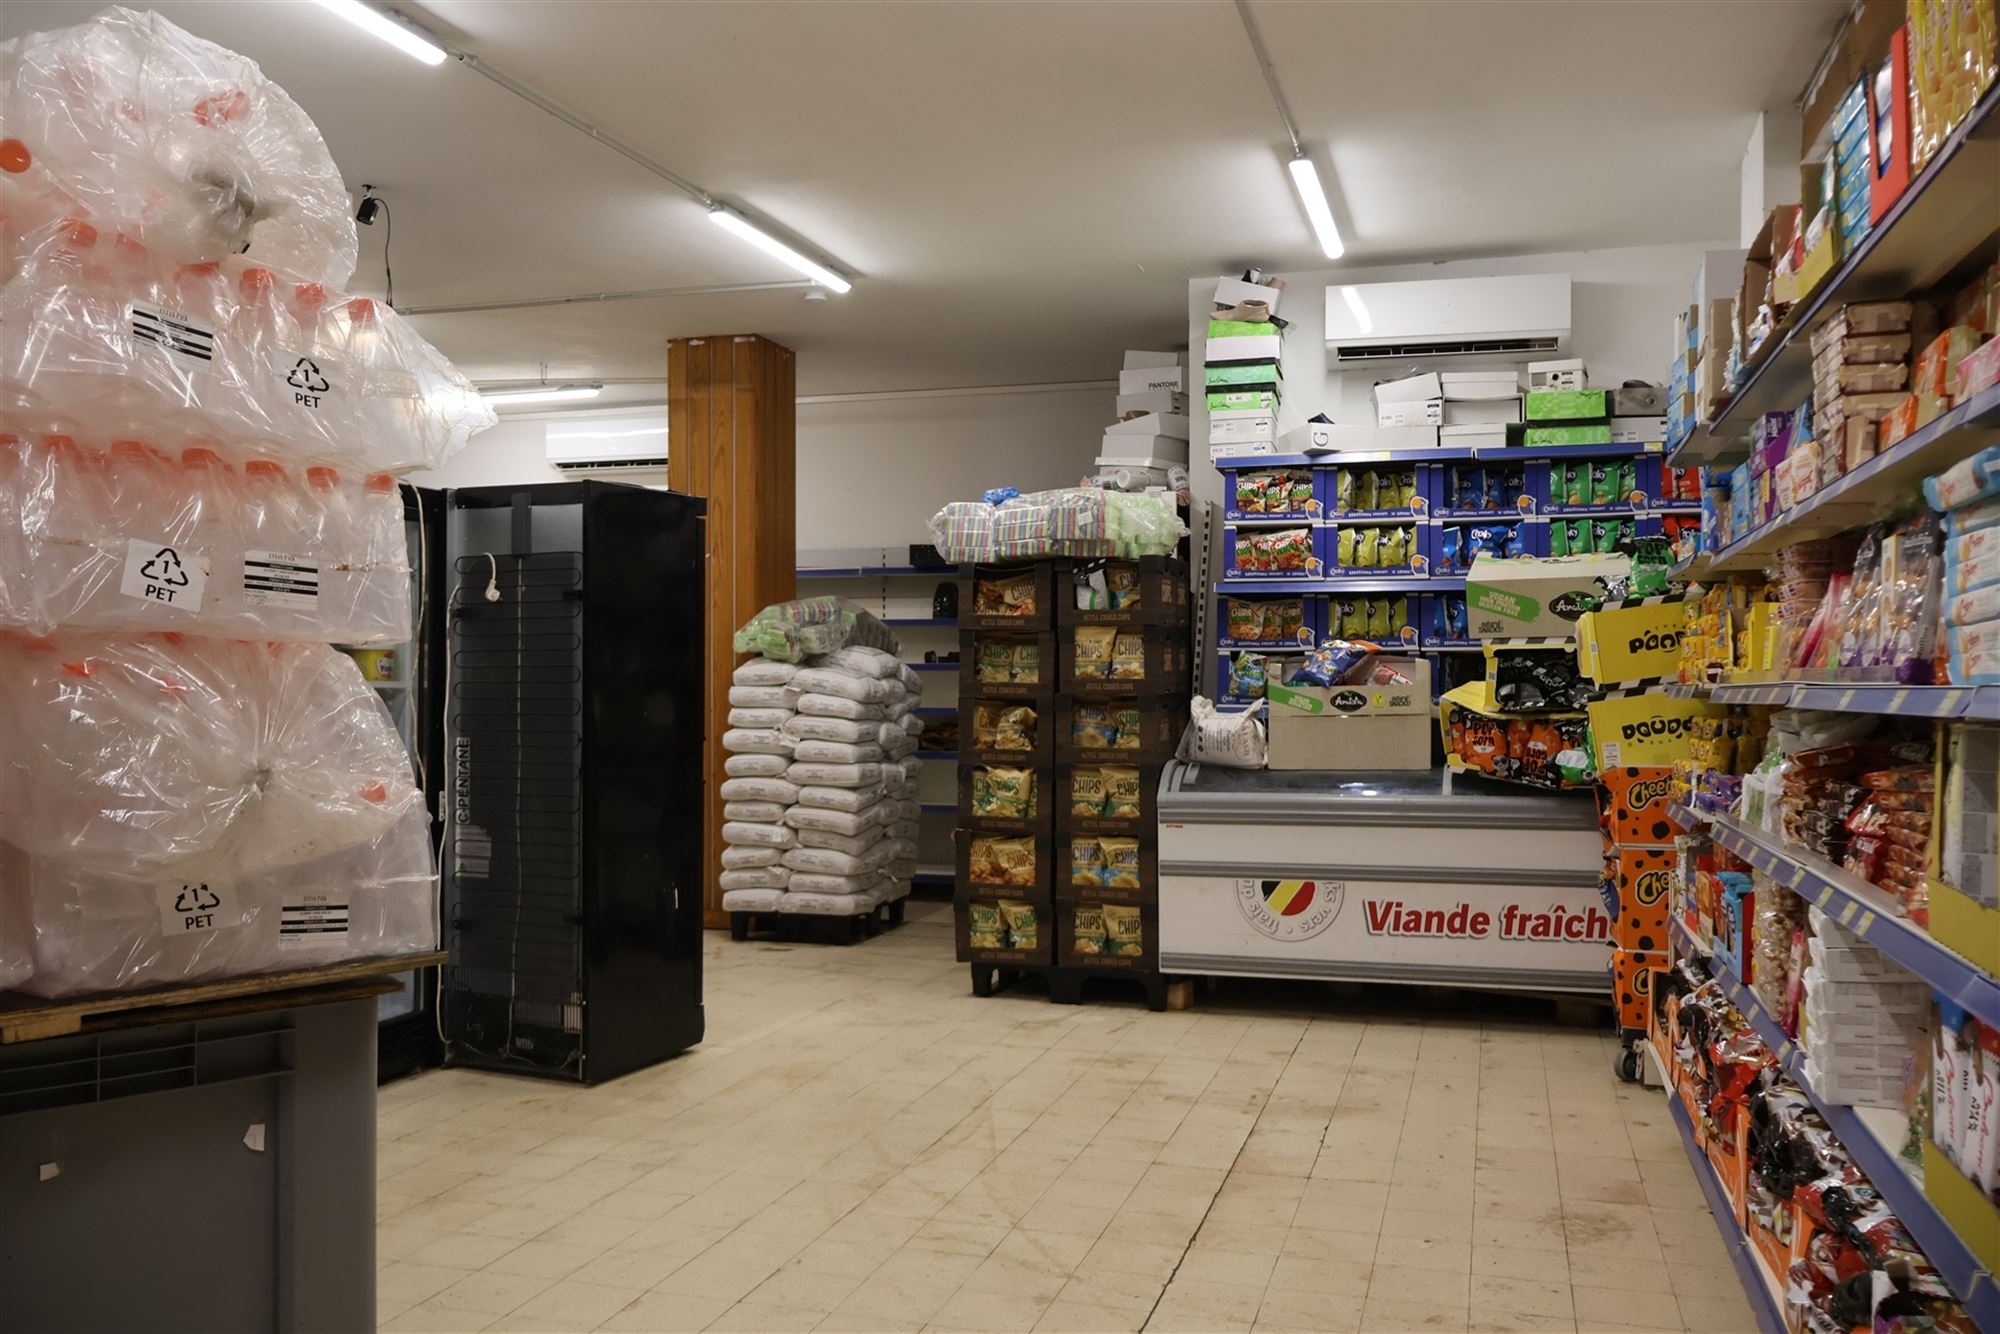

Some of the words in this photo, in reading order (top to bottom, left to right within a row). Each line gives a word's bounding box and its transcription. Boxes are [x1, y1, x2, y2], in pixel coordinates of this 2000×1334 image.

[1148, 381, 1178, 389] PANTONE
[295, 392, 321, 408] PET
[1237, 482, 1258, 491] CHIPS
[1292, 483, 1313, 492] CHIPS
[1471, 529, 1492, 540] Croky
[1235, 540, 1251, 549] HIPS
[145, 584, 177, 602] PET
[984, 645, 1011, 659] CHIPS
[1075, 644, 1103, 659] CHIPS
[1119, 711, 1140, 727] CHIP
[1473, 722, 1495, 735] POP
[457, 737, 470, 822] C-PENTANE
[1072, 778, 1101, 794] CHIPS
[1629, 777, 1673, 810] Cheet
[1007, 852, 1034, 870] CHIPS
[1073, 847, 1100, 862] CHIPS
[185, 914, 214, 930] PET
[972, 909, 998, 924] CHIPS
[1013, 911, 1036, 930] CHIP
[1074, 913, 1101, 930] CHIPS
[1366, 899, 1490, 936] Viande
[1503, 903, 1607, 940] fraîch
[1118, 919, 1140, 935] CHIP
